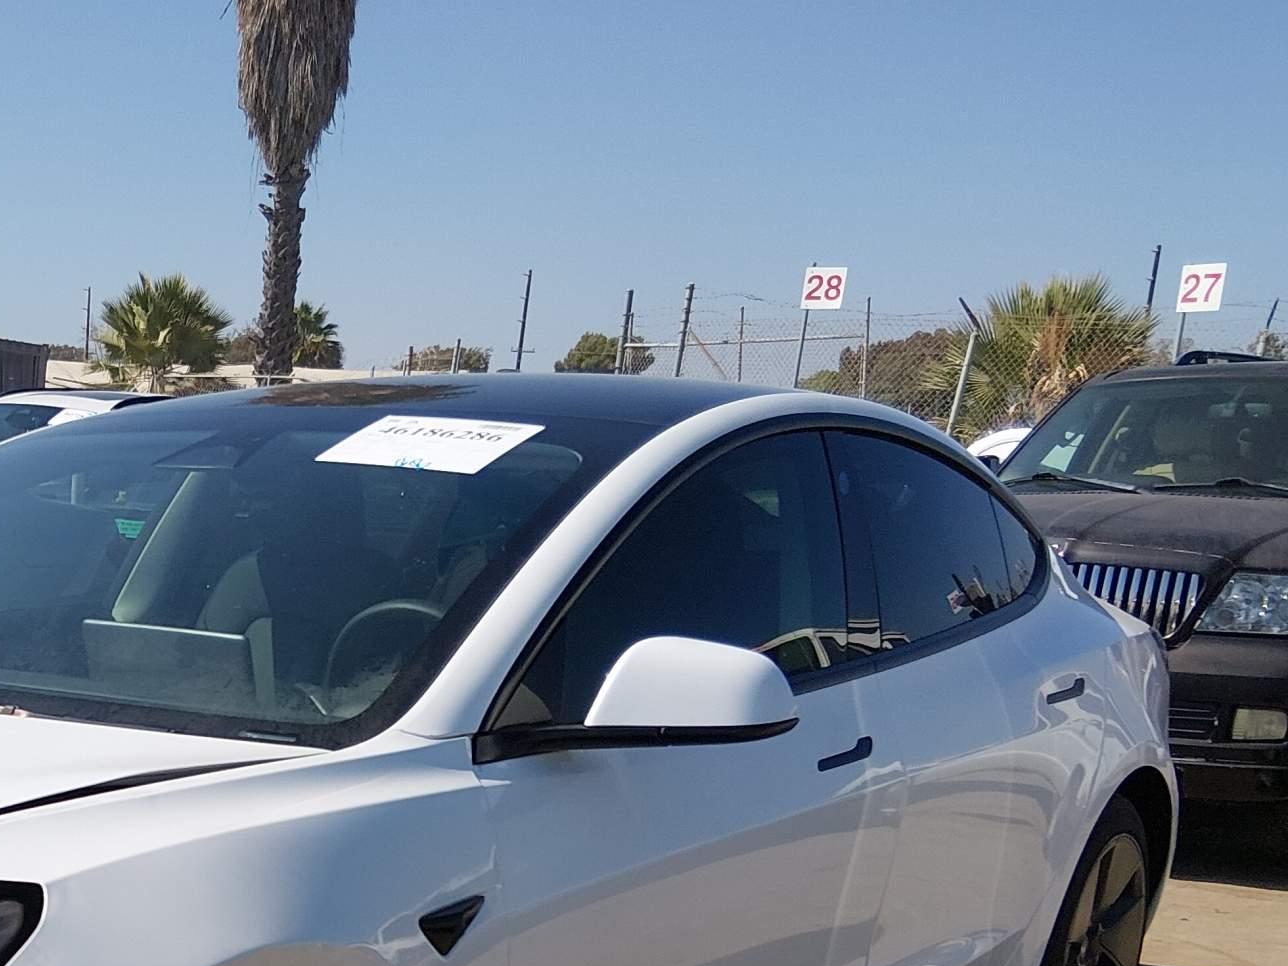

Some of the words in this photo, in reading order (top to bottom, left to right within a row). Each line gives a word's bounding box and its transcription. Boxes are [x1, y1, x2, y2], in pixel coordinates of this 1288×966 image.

[804, 274, 843, 301] 28
[1180, 272, 1223, 303] 27
[378, 426, 503, 442] 46186286
